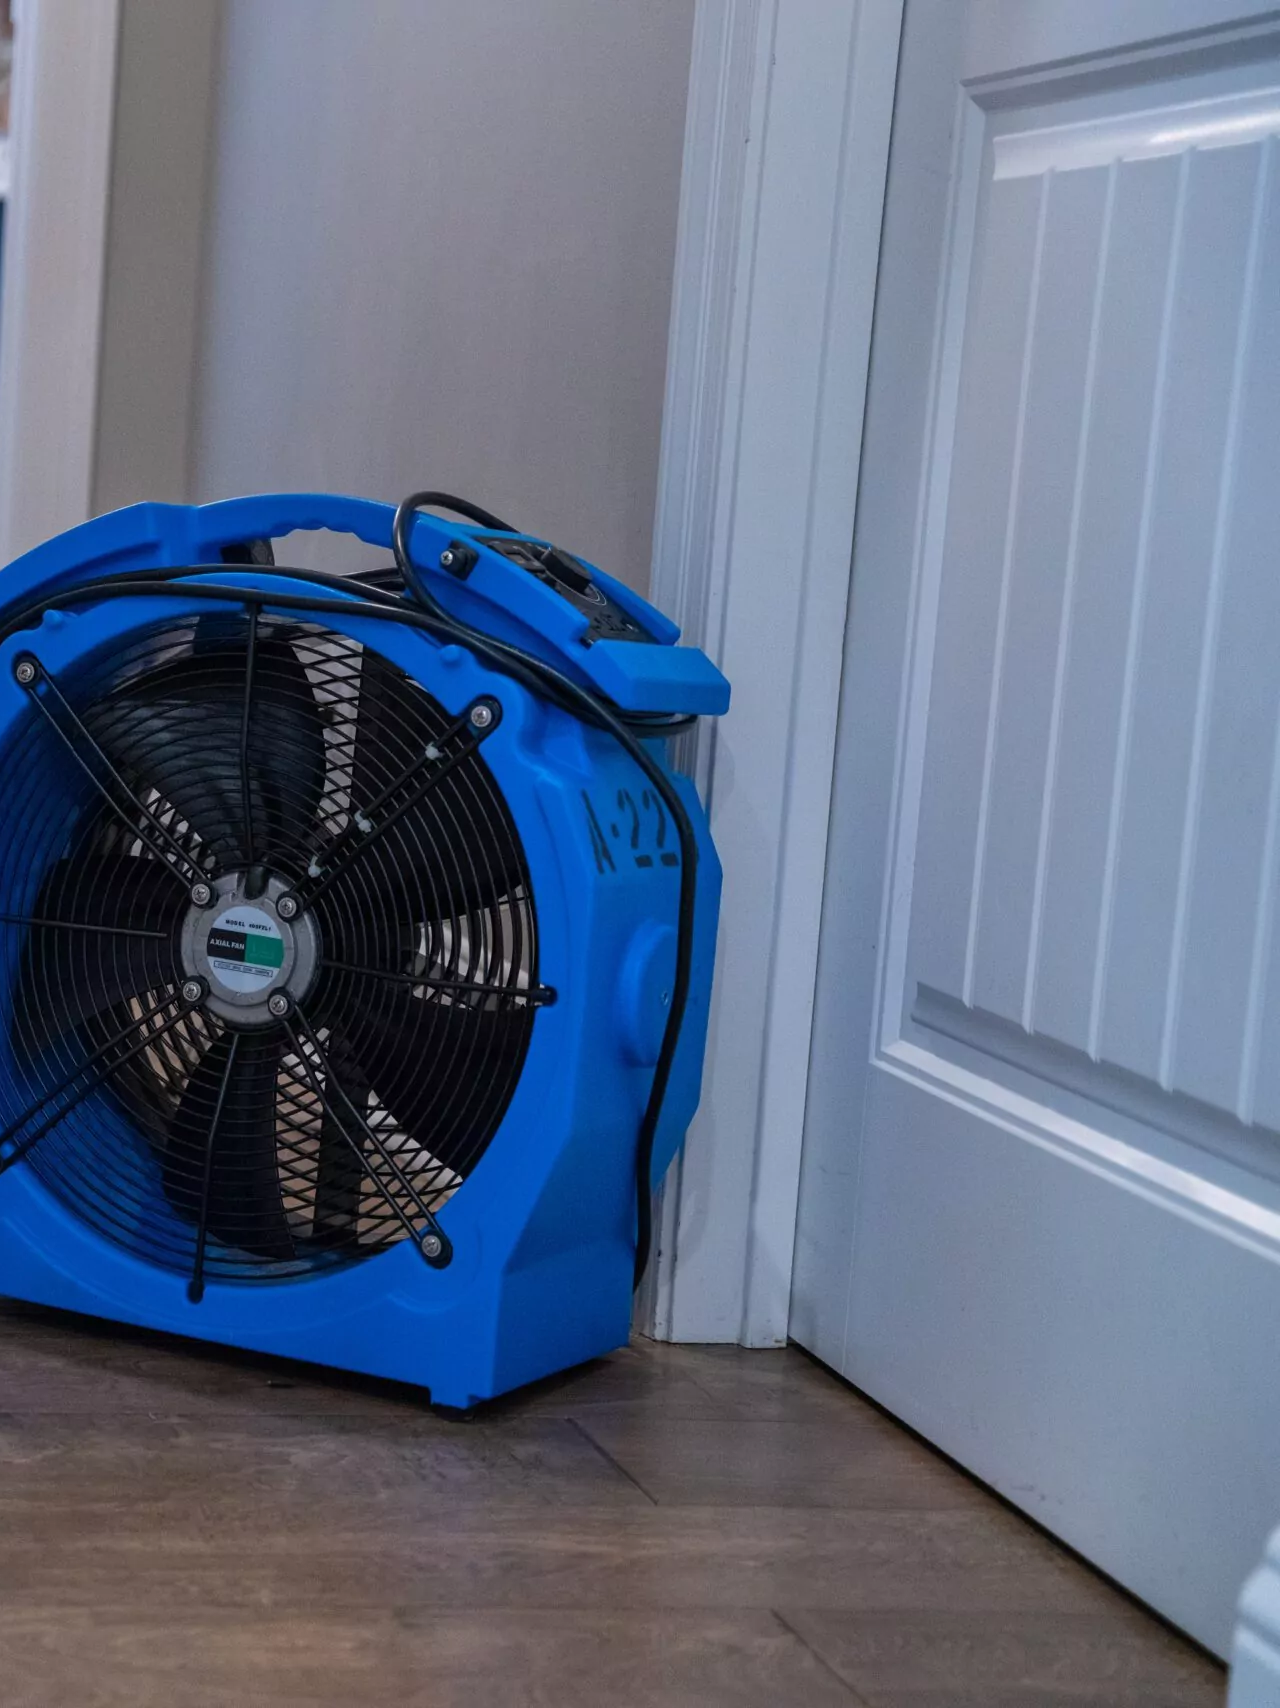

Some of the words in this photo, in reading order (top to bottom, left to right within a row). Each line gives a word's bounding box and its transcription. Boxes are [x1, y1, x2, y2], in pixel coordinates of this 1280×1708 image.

[225, 919, 245, 927] MODEL
[210, 938, 230, 948] AXIAL
[231, 941, 245, 950] FAN
